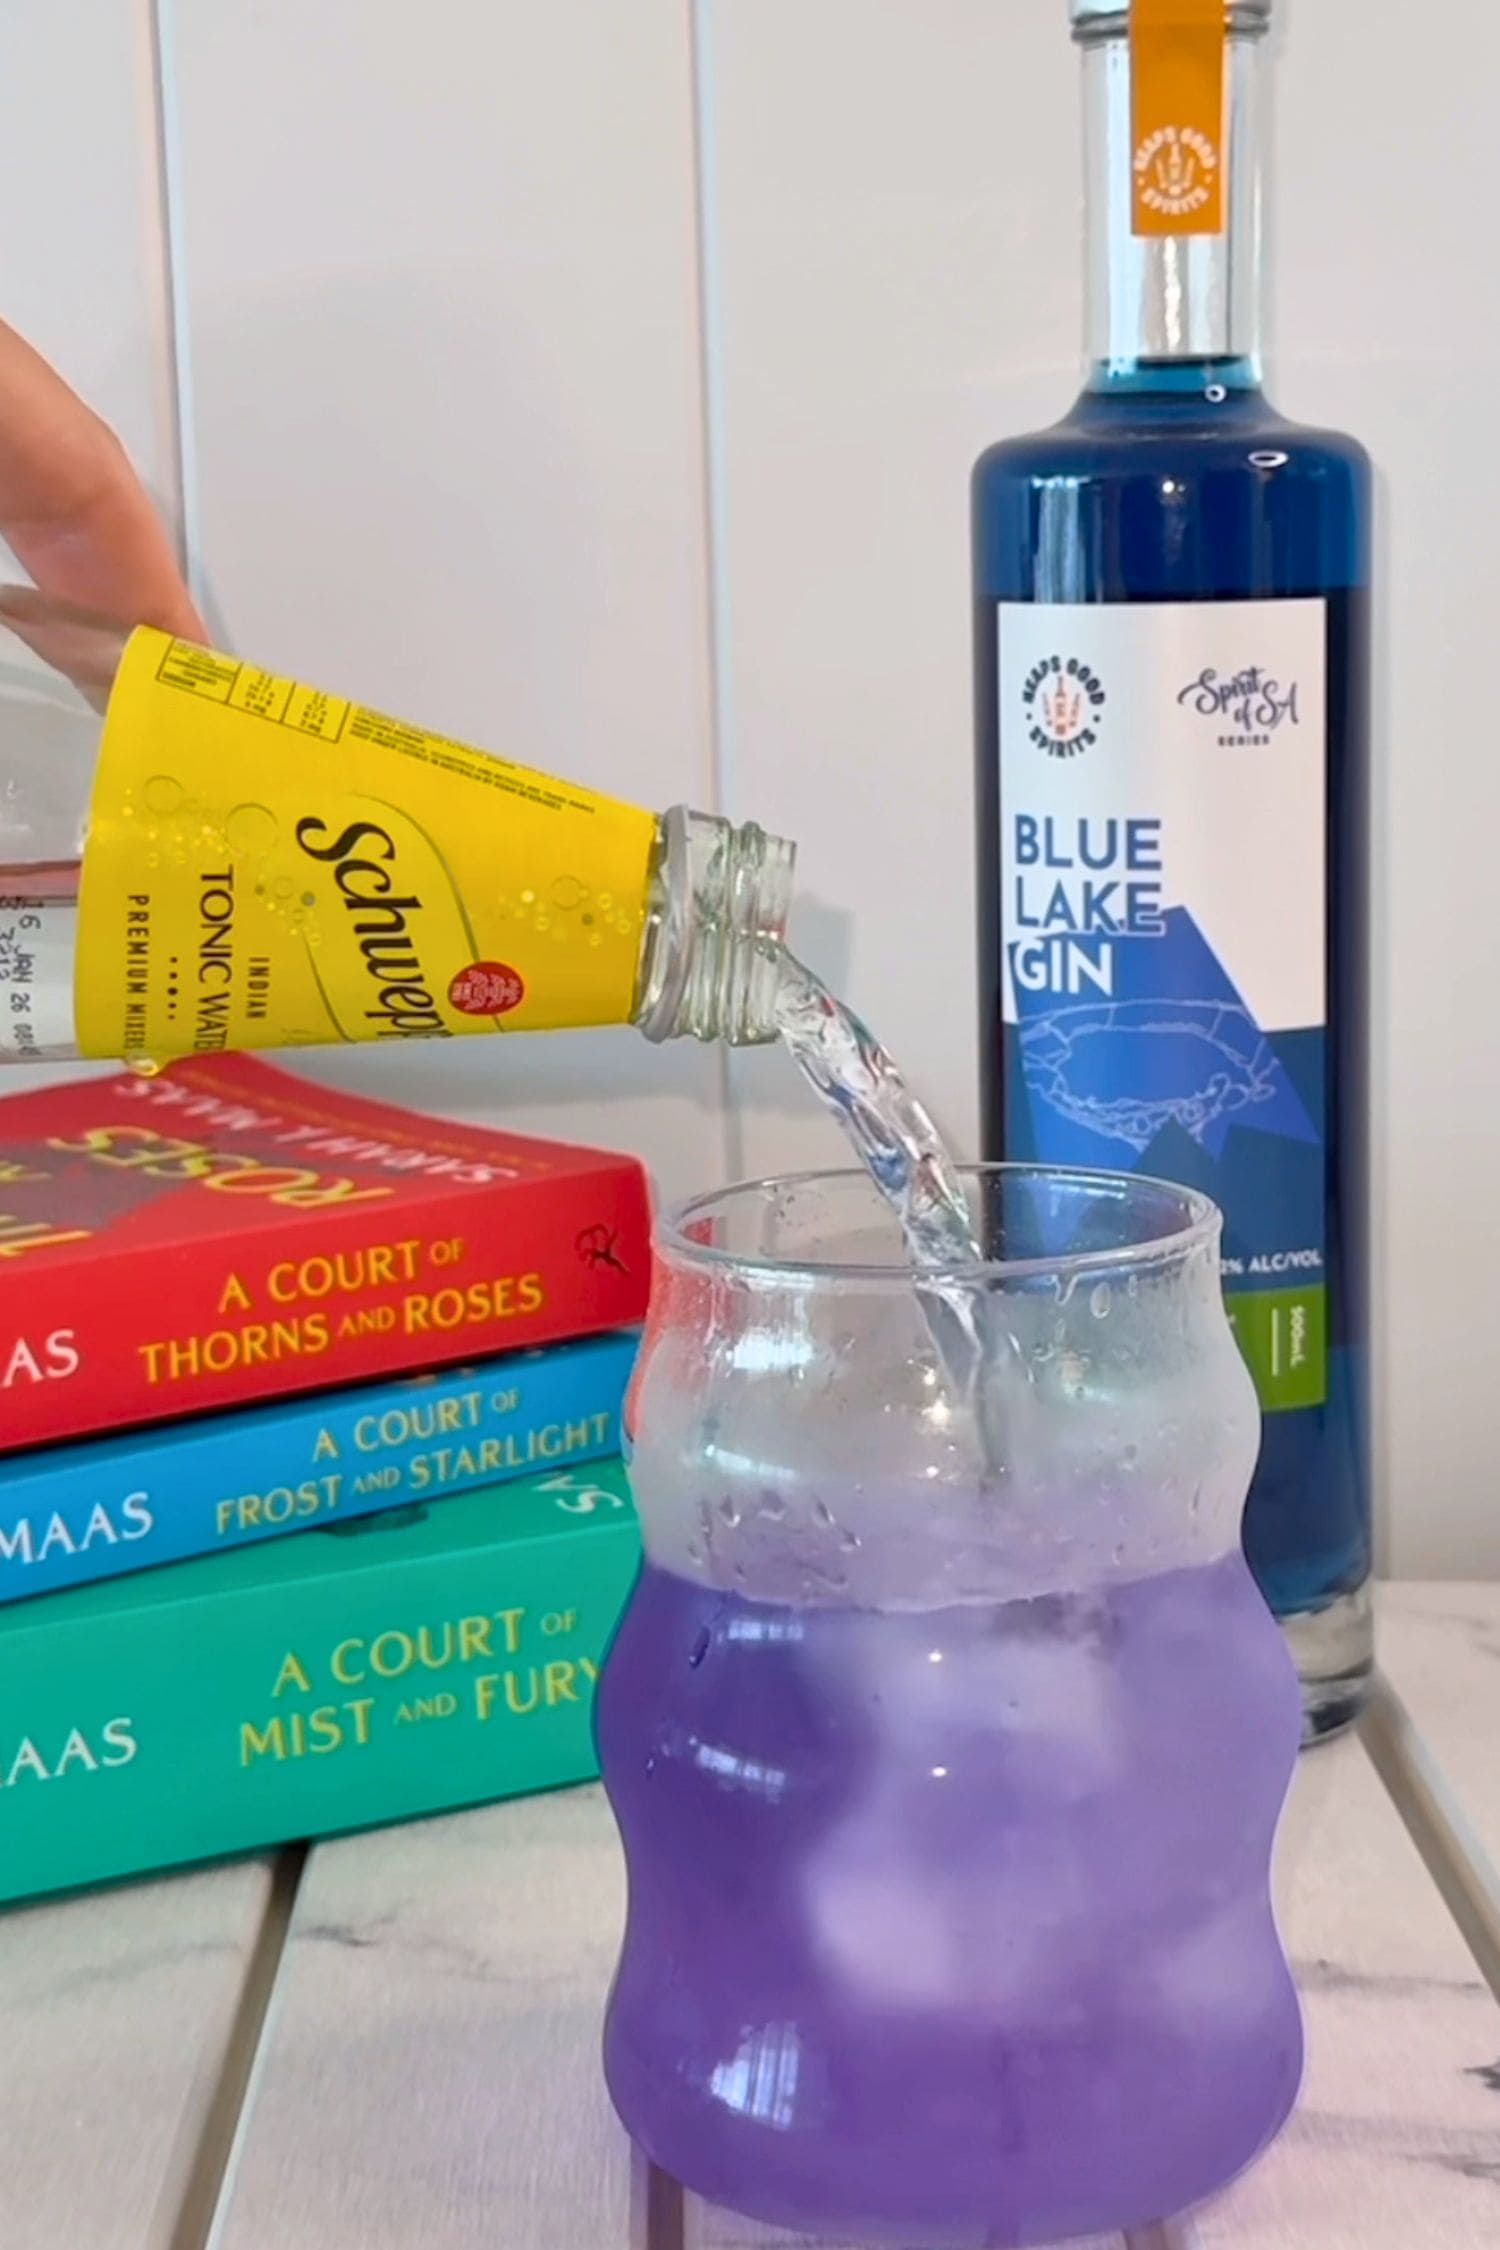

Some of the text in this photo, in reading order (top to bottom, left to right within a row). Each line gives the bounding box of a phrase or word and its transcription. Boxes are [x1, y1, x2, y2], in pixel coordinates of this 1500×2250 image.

[1022, 655, 1105, 705] HEAPS GOOD
[1177, 666, 1263, 714] Spirit
[1029, 725, 1096, 758] SPIRITS
[1014, 814, 1162, 871] BLUE
[199, 864, 234, 984] TONIC
[1016, 875, 1164, 936] LAKE
[127, 894, 150, 994] PREMIUM
[1013, 937, 1113, 997] GIN
[246, 957, 270, 1019] INDIAN
[46, 1125, 395, 1208] ROSES
[218, 1237, 464, 1315] A COURT OF
[1248, 1249, 1324, 1274] ALC/VOL
[138, 1273, 544, 1384] THORNS AND ROSES
[313, 1388, 521, 1463] A COURT OF
[215, 1412, 610, 1536] FROST AND STARLIGHT
[271, 1607, 577, 1698] A COURT OF
[239, 1697, 375, 1768] MIST
[393, 1692, 458, 1726] AND
